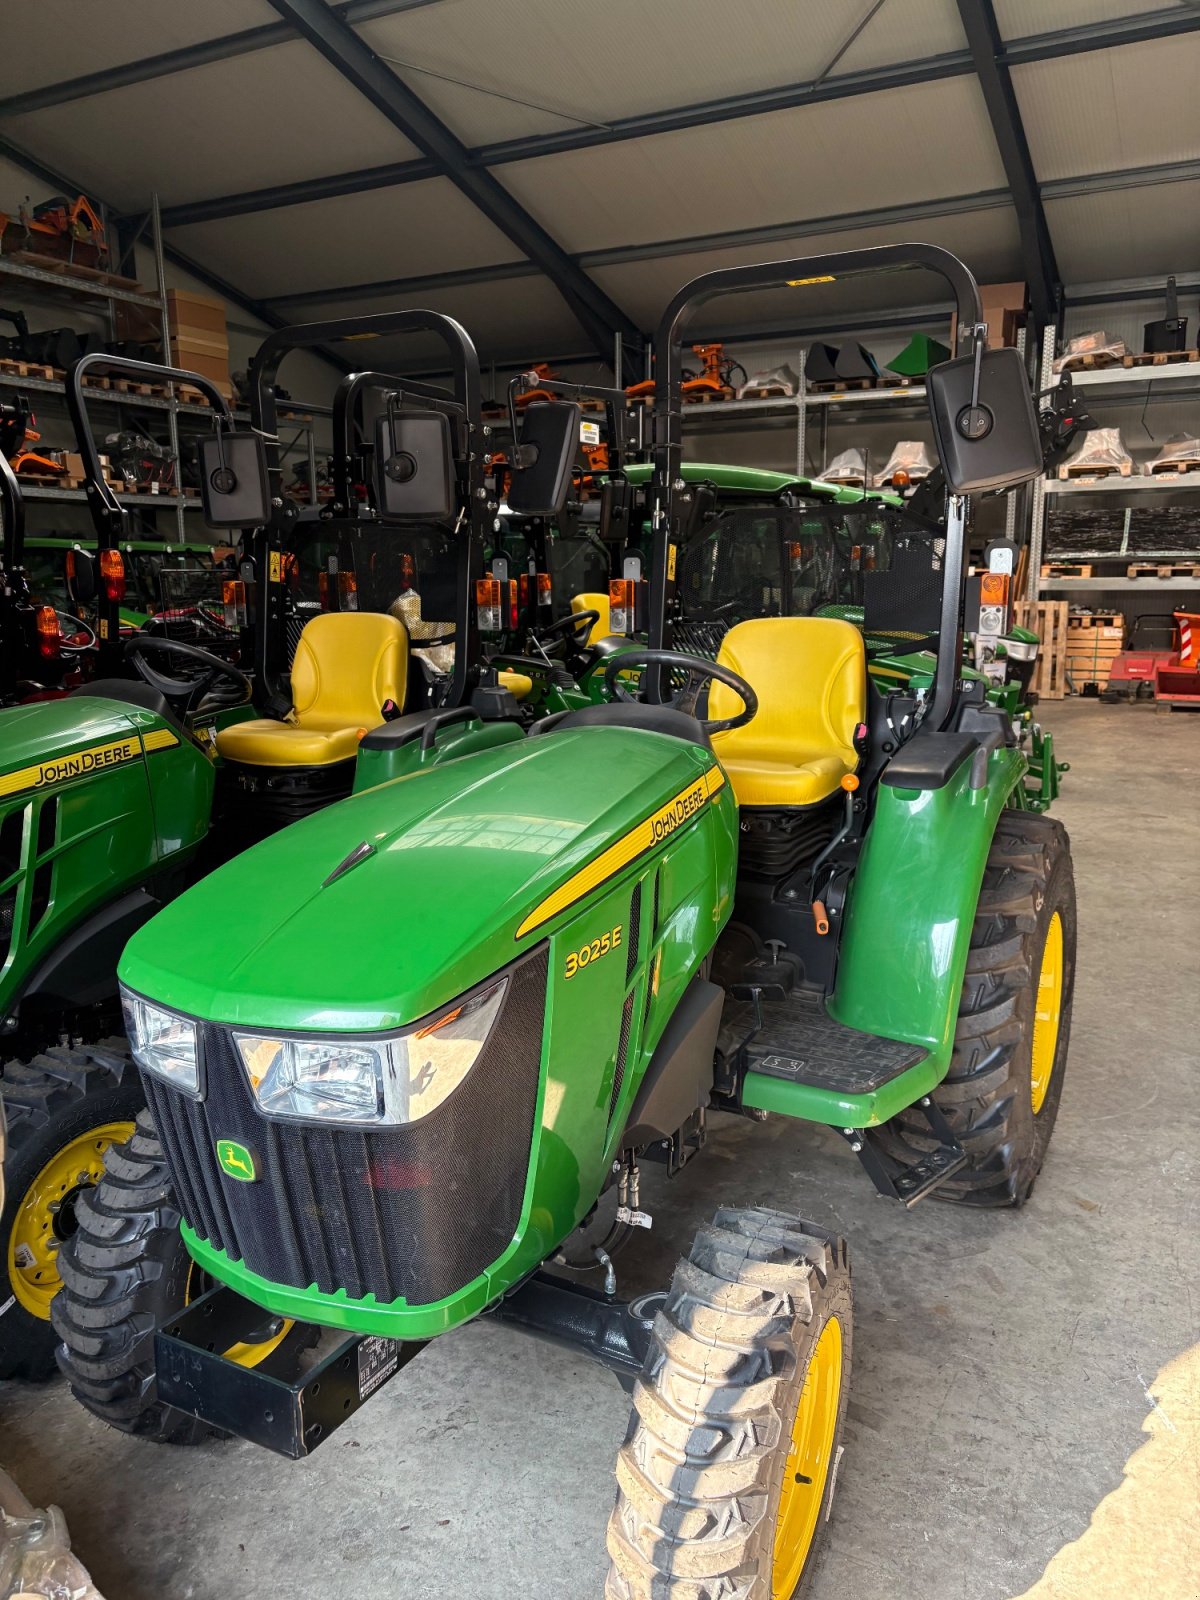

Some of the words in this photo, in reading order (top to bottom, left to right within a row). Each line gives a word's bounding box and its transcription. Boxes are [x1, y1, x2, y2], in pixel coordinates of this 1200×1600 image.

[35, 759, 80, 786] JOHN
[81, 744, 132, 771] DEERE
[649, 808, 677, 845] JOHN
[676, 786, 705, 822] DEERE
[565, 924, 622, 979] 3025E
